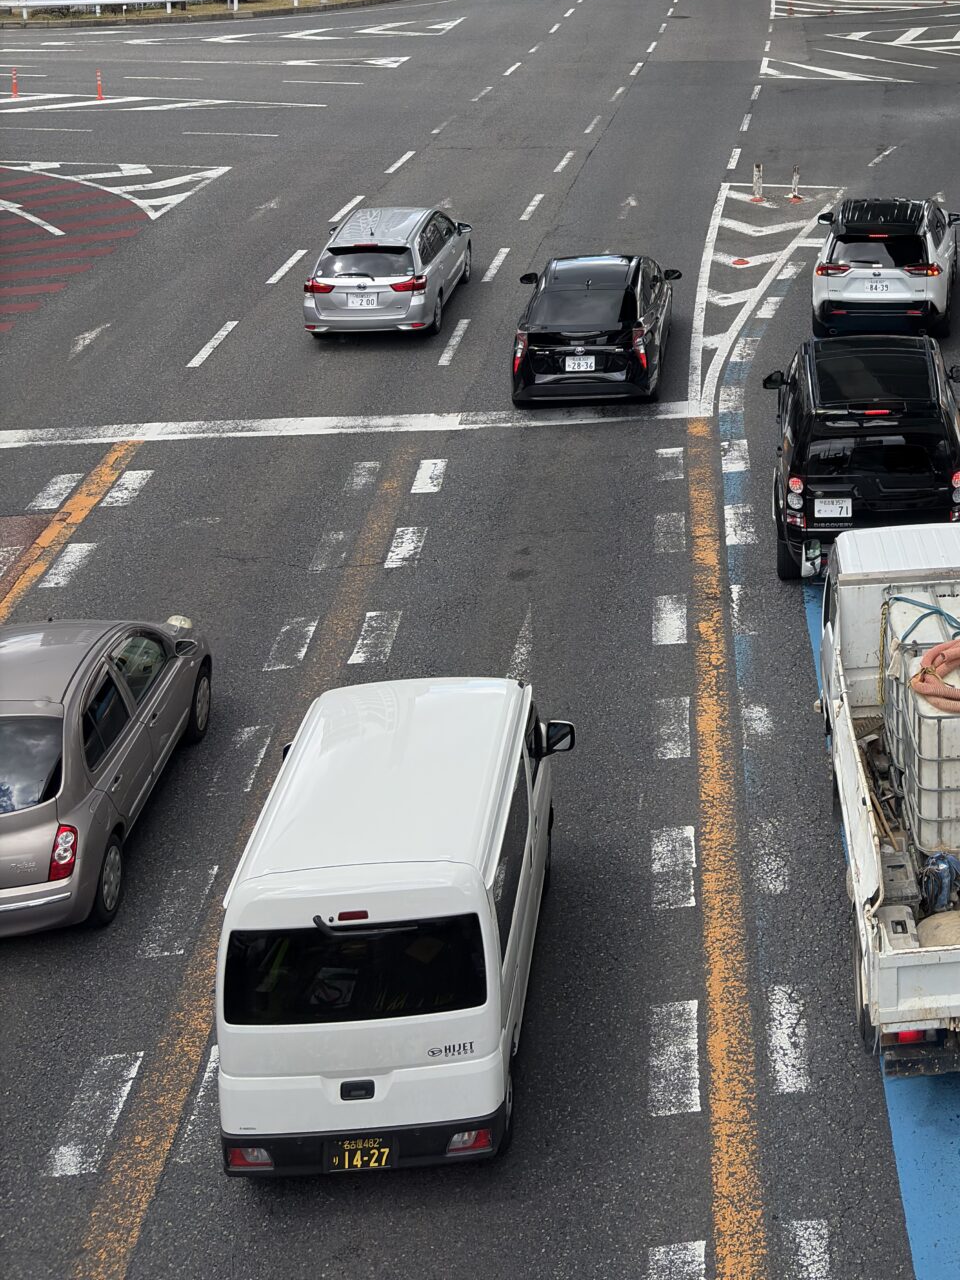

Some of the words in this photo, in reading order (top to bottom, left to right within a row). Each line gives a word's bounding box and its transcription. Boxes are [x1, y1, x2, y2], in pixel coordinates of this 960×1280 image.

[572, 361, 594, 370] 28-36
[444, 1041, 475, 1053] HIJET
[444, 1049, 475, 1057] CARGO
[344, 1147, 390, 1169] 14-27
